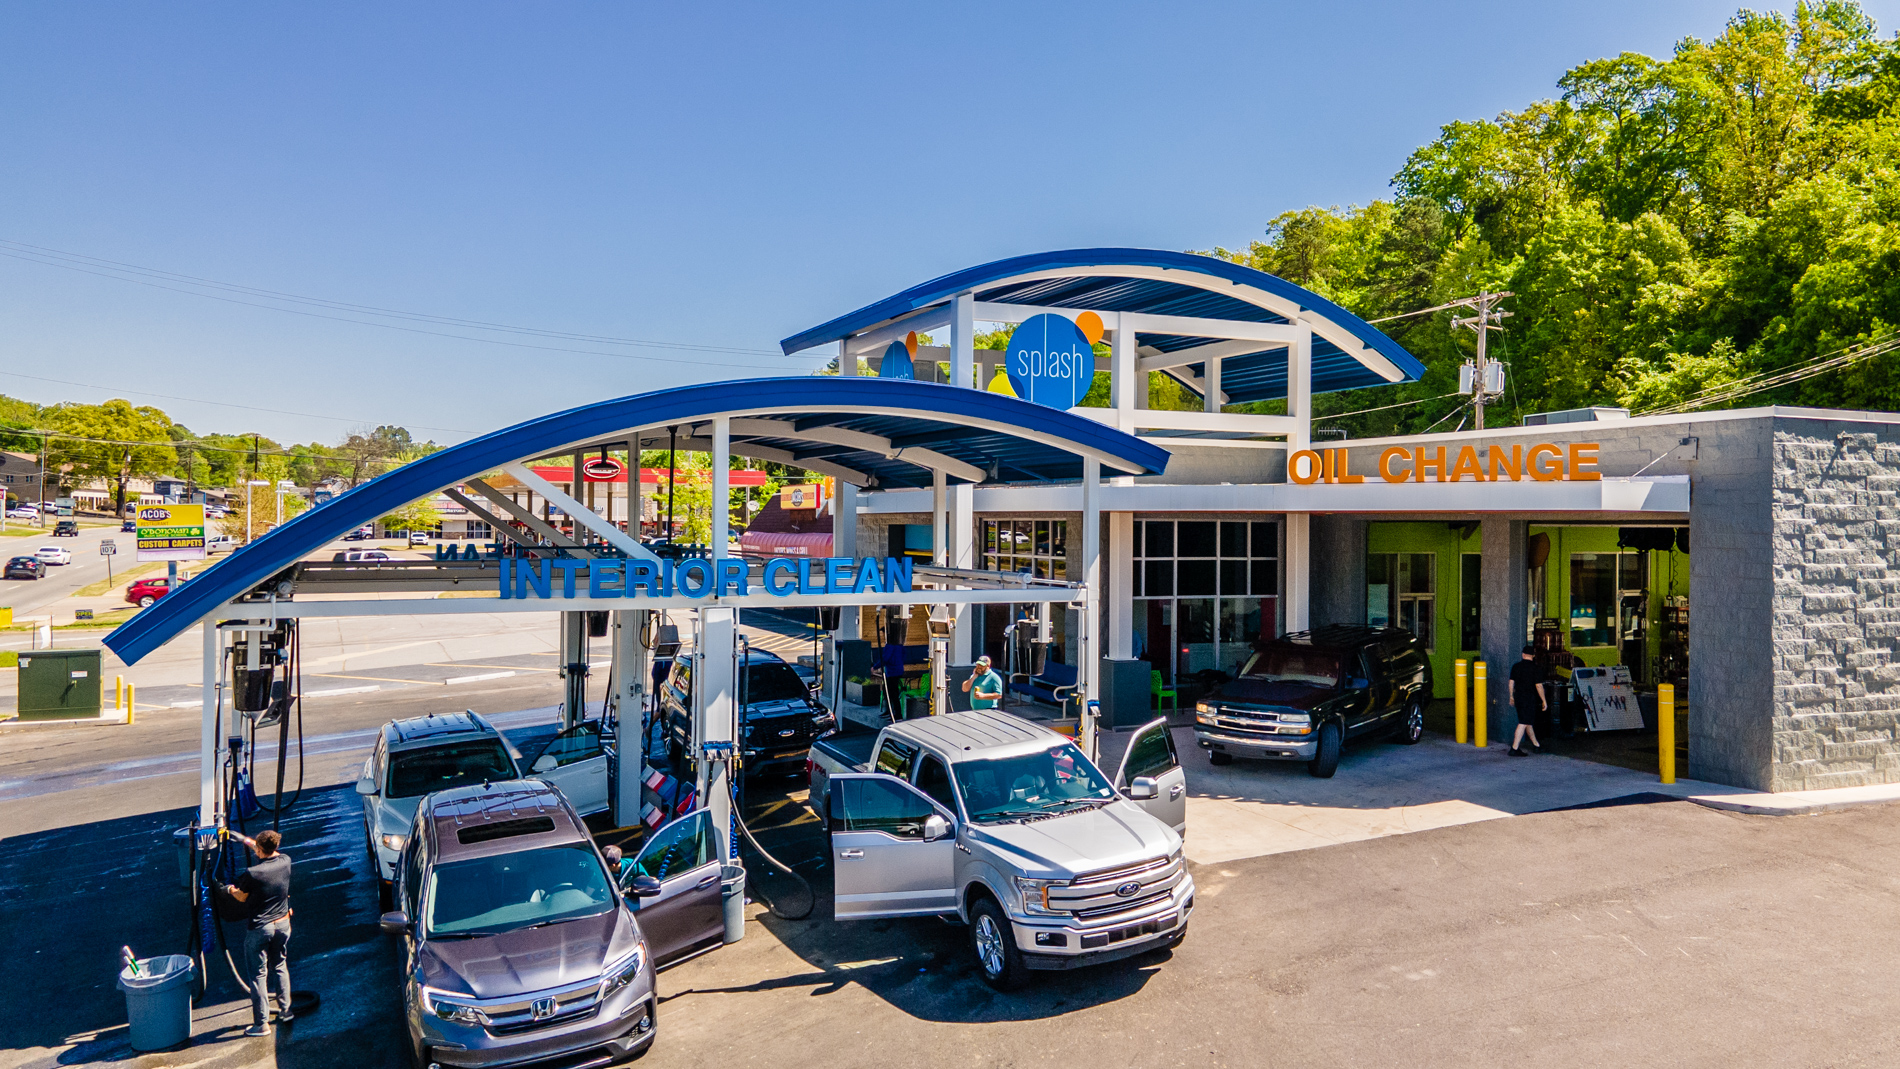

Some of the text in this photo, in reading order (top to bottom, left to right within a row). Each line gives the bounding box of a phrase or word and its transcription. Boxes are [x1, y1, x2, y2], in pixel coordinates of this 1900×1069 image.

[1018, 313, 1083, 407] splash
[1288, 443, 1602, 485] OIL CHANGE
[138, 509, 171, 519] JACOB'S
[138, 539, 203, 549] CUSTOM CARPETS
[499, 556, 913, 599] INTERIOR CLEAN
